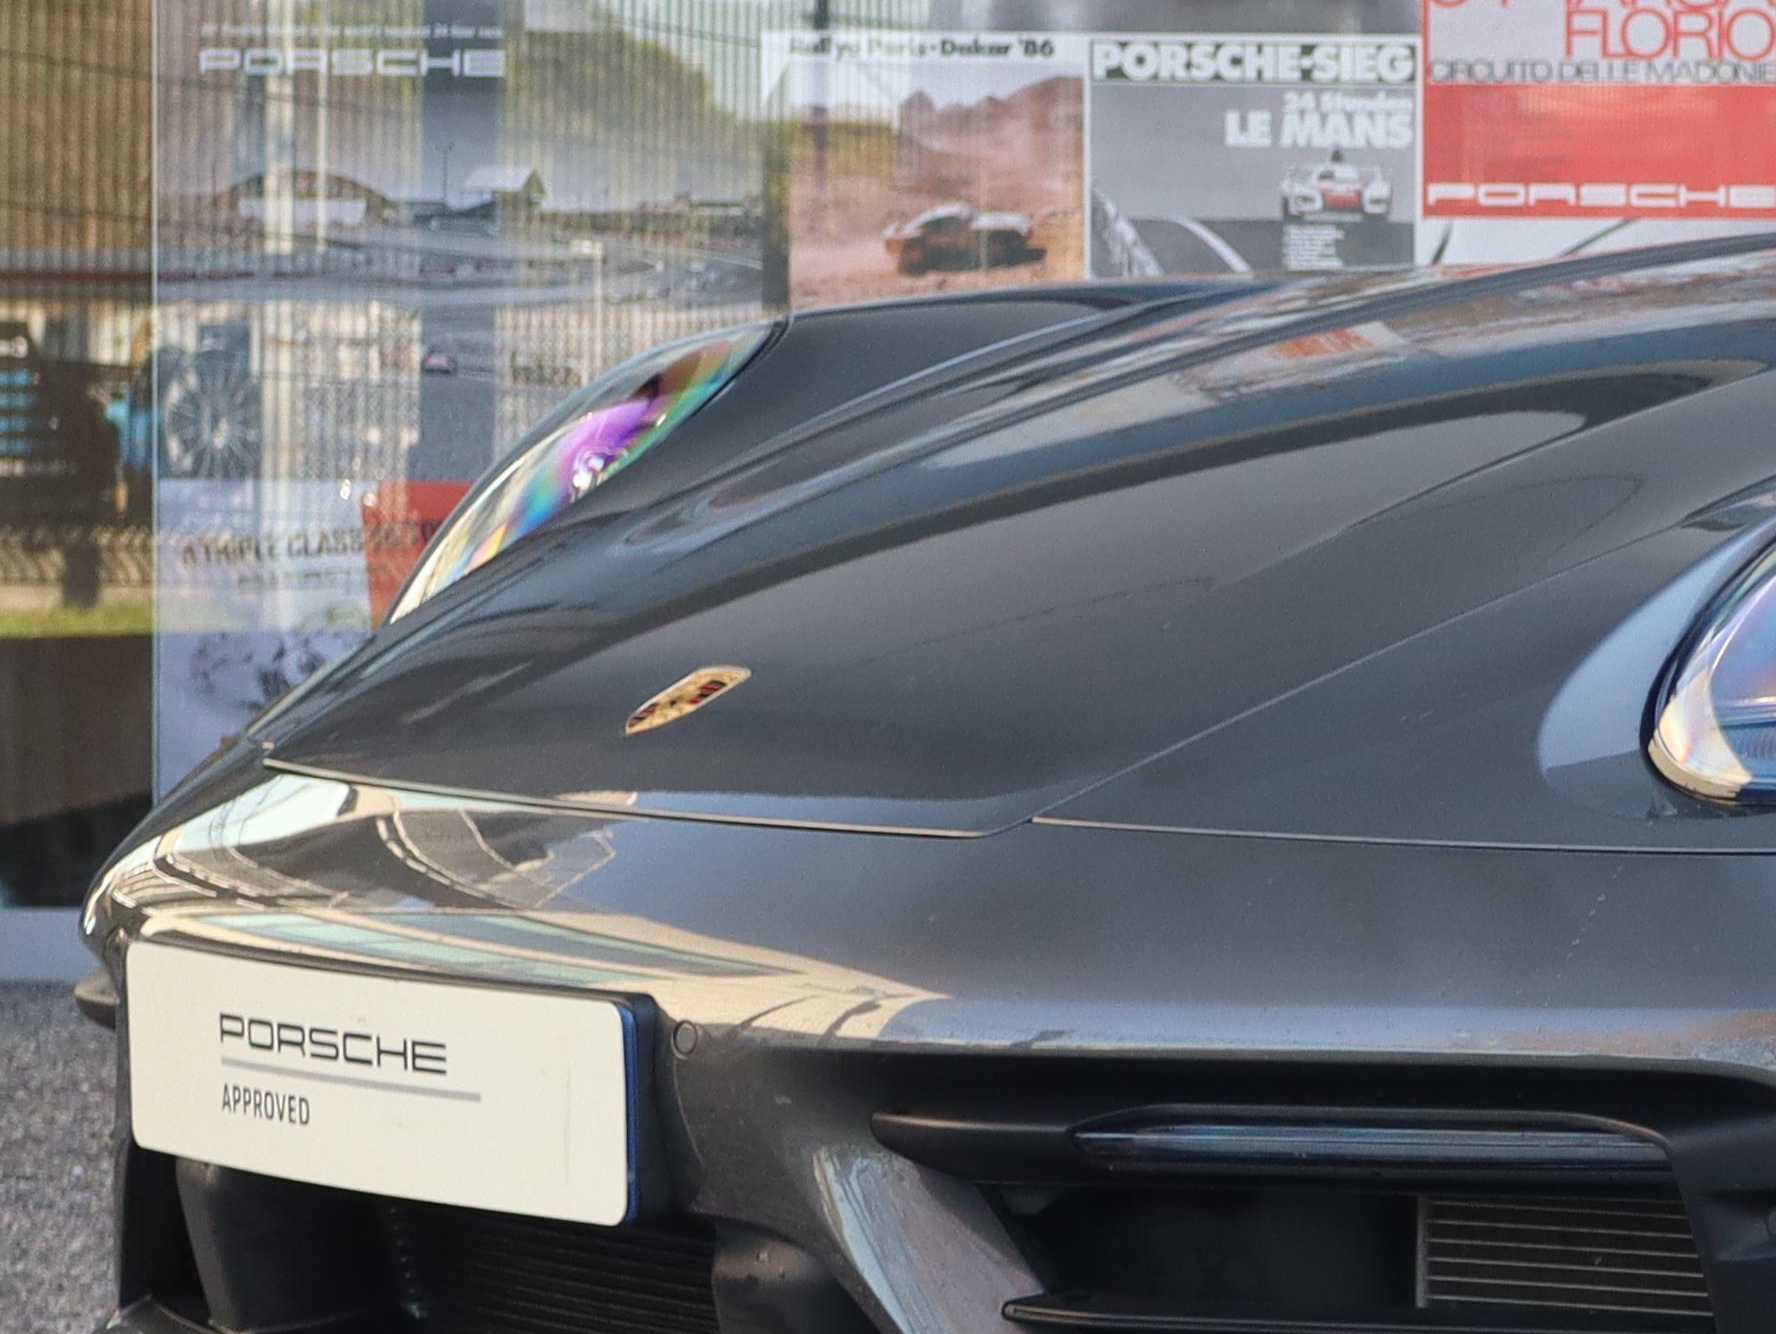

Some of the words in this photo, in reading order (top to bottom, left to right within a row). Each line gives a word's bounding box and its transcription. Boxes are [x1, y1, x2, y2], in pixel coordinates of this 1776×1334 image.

[1565, 9, 1776, 60] FLORIO
[199, 48, 506, 77] PORSCHE
[1092, 43, 1414, 82] PORSCHE-SIEG
[1429, 59, 1553, 84] CIRCUITO
[1557, 59, 1640, 84] DELLE
[1645, 59, 1776, 84] MADONIE
[1225, 112, 1272, 148] LE
[1281, 112, 1413, 149] MANS
[286, 528, 364, 558] CLASS
[219, 1013, 447, 1076] PORSCHE
[221, 1082, 311, 1127] APPROVED
